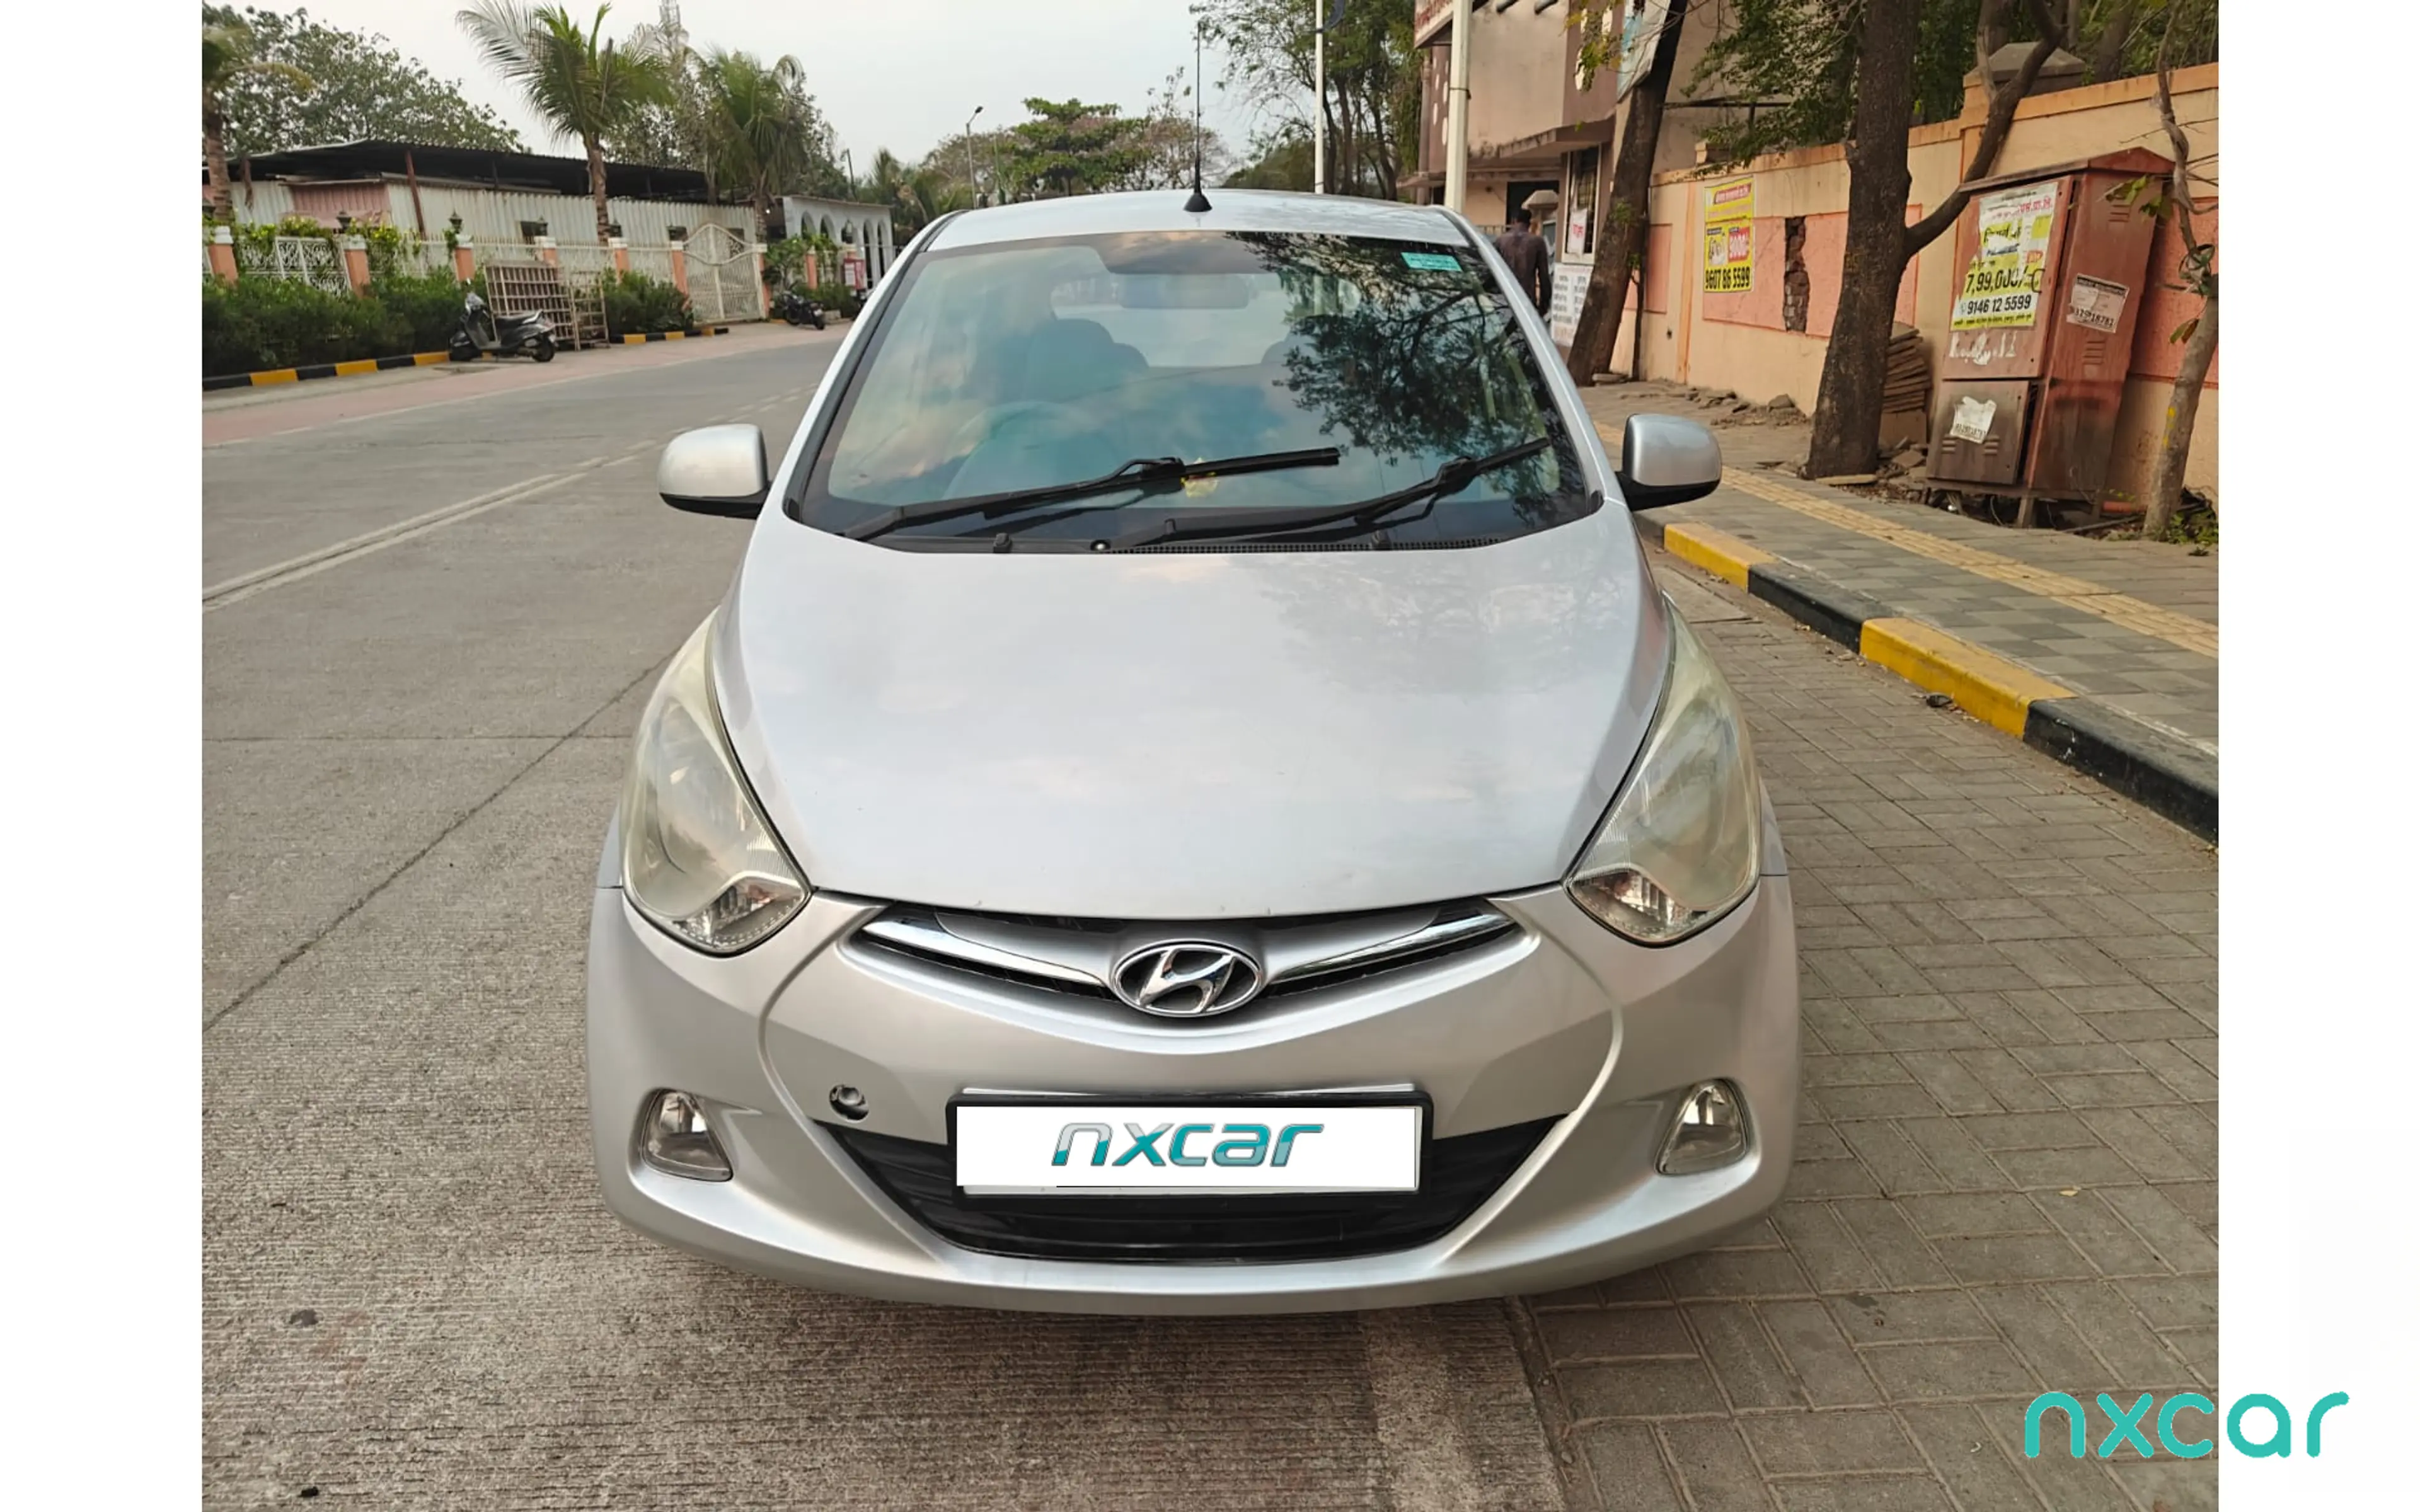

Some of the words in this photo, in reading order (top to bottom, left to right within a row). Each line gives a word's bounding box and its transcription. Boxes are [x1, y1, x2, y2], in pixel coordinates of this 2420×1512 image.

[1705, 268, 1721, 289] 9607
[1722, 268, 1731, 289] 86
[1732, 266, 1749, 288] 5599
[1967, 299, 1990, 315] 9146
[1991, 297, 2003, 312] 12
[2004, 294, 2031, 311] 5599
